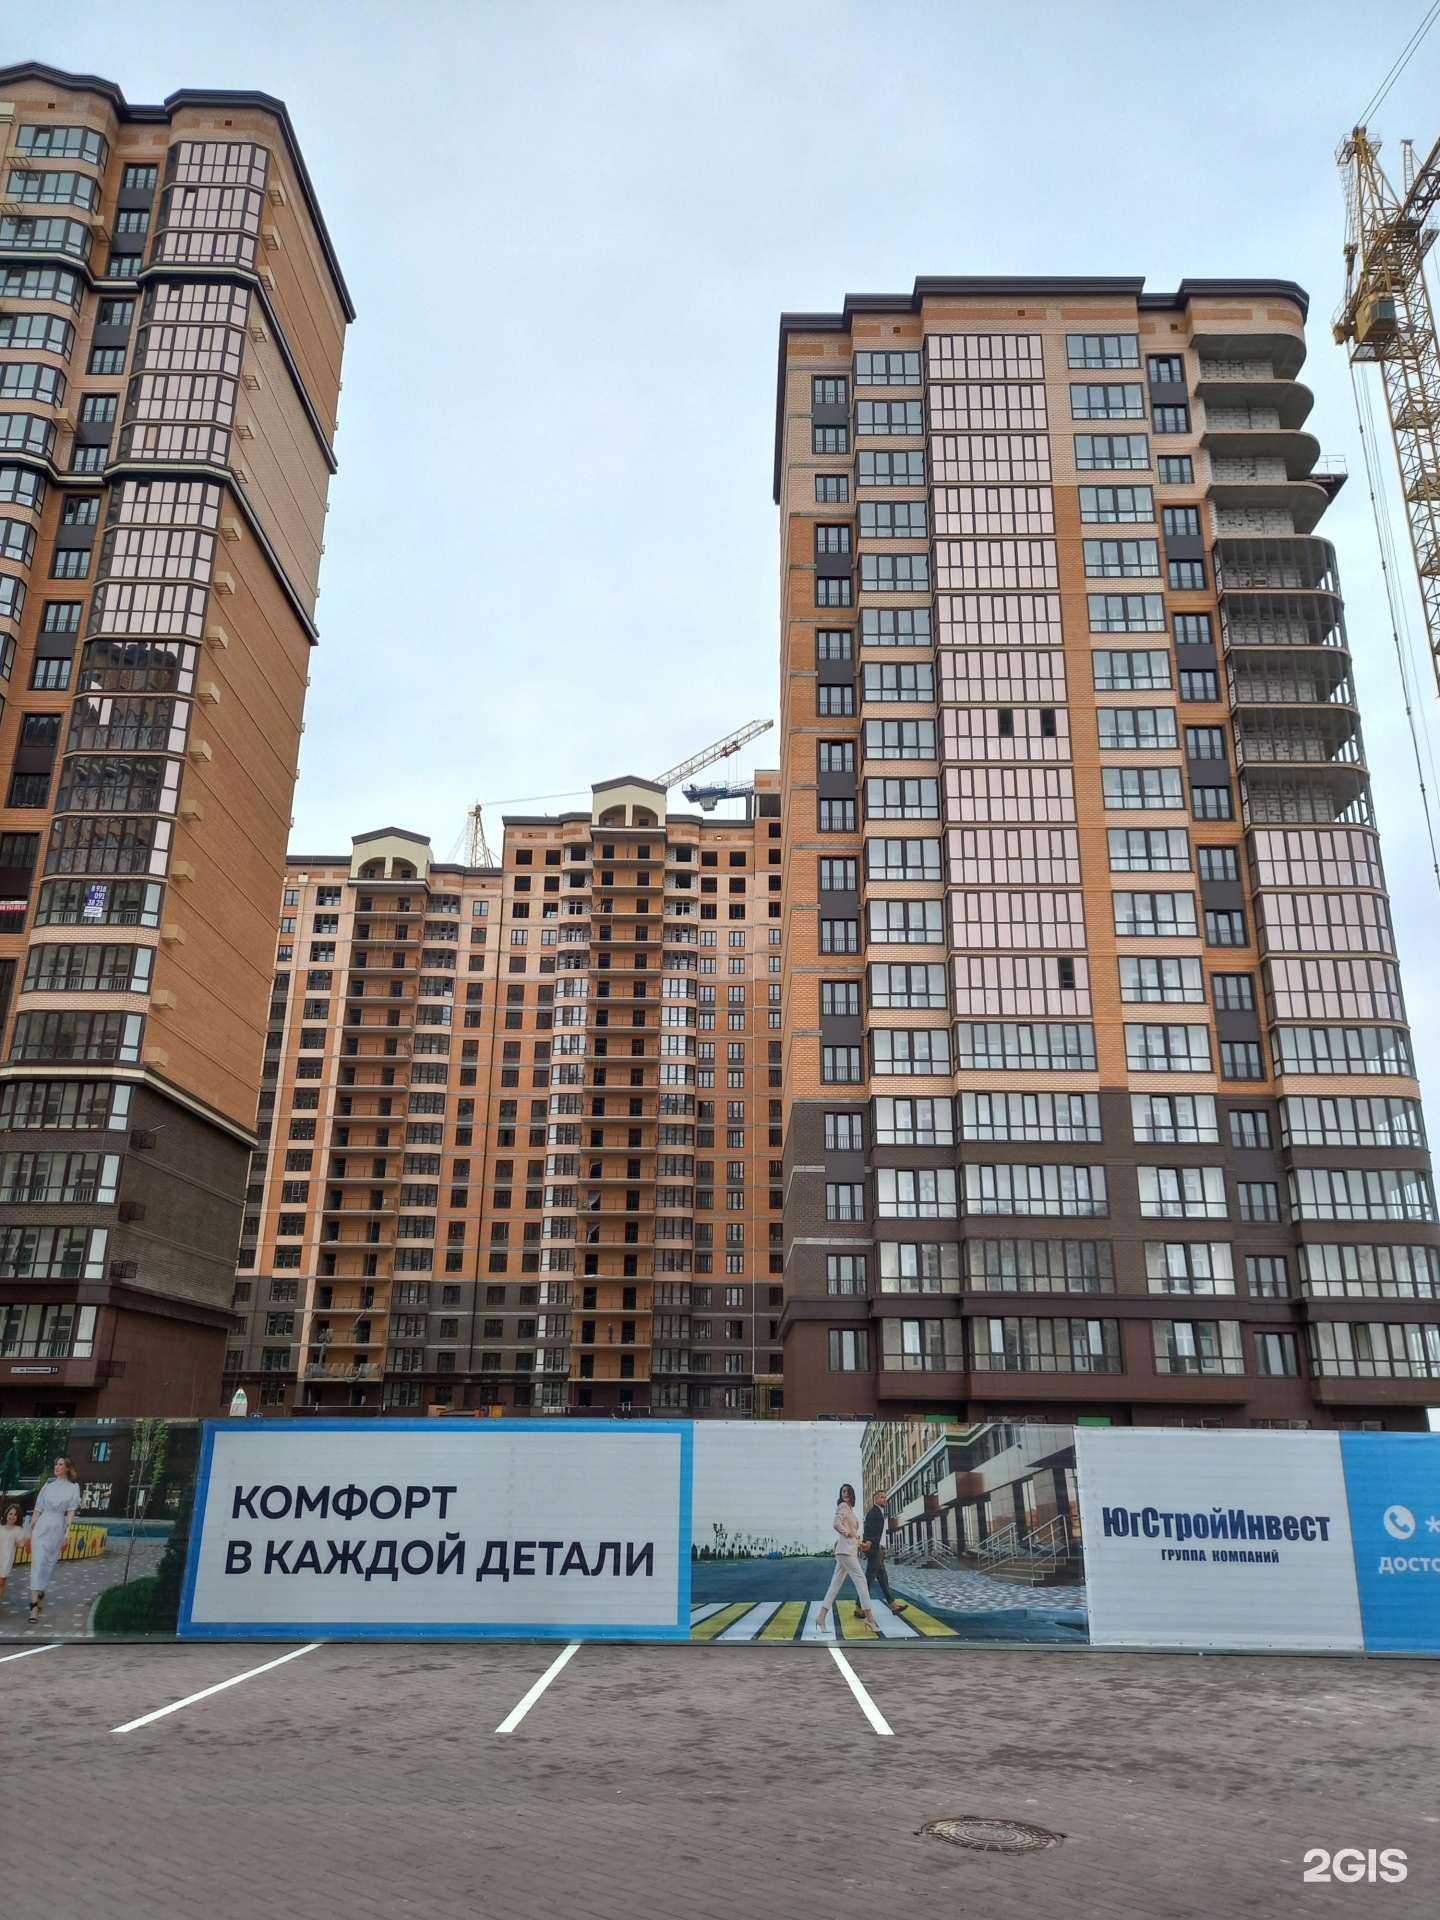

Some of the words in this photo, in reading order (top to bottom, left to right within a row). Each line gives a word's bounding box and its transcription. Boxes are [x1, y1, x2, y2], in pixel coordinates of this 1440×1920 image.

[231, 1483, 458, 1521] КОМФОРТ
[1101, 1506, 1331, 1542] ЮгСтройИнвест
[224, 1540, 253, 1575] В
[263, 1531, 466, 1582] КАЖДОЙ
[475, 1540, 654, 1582] ДЕТАЛИ
[1161, 1548, 1207, 1562] ГРУППА
[1212, 1549, 1280, 1564] КОМПАНИЙ
